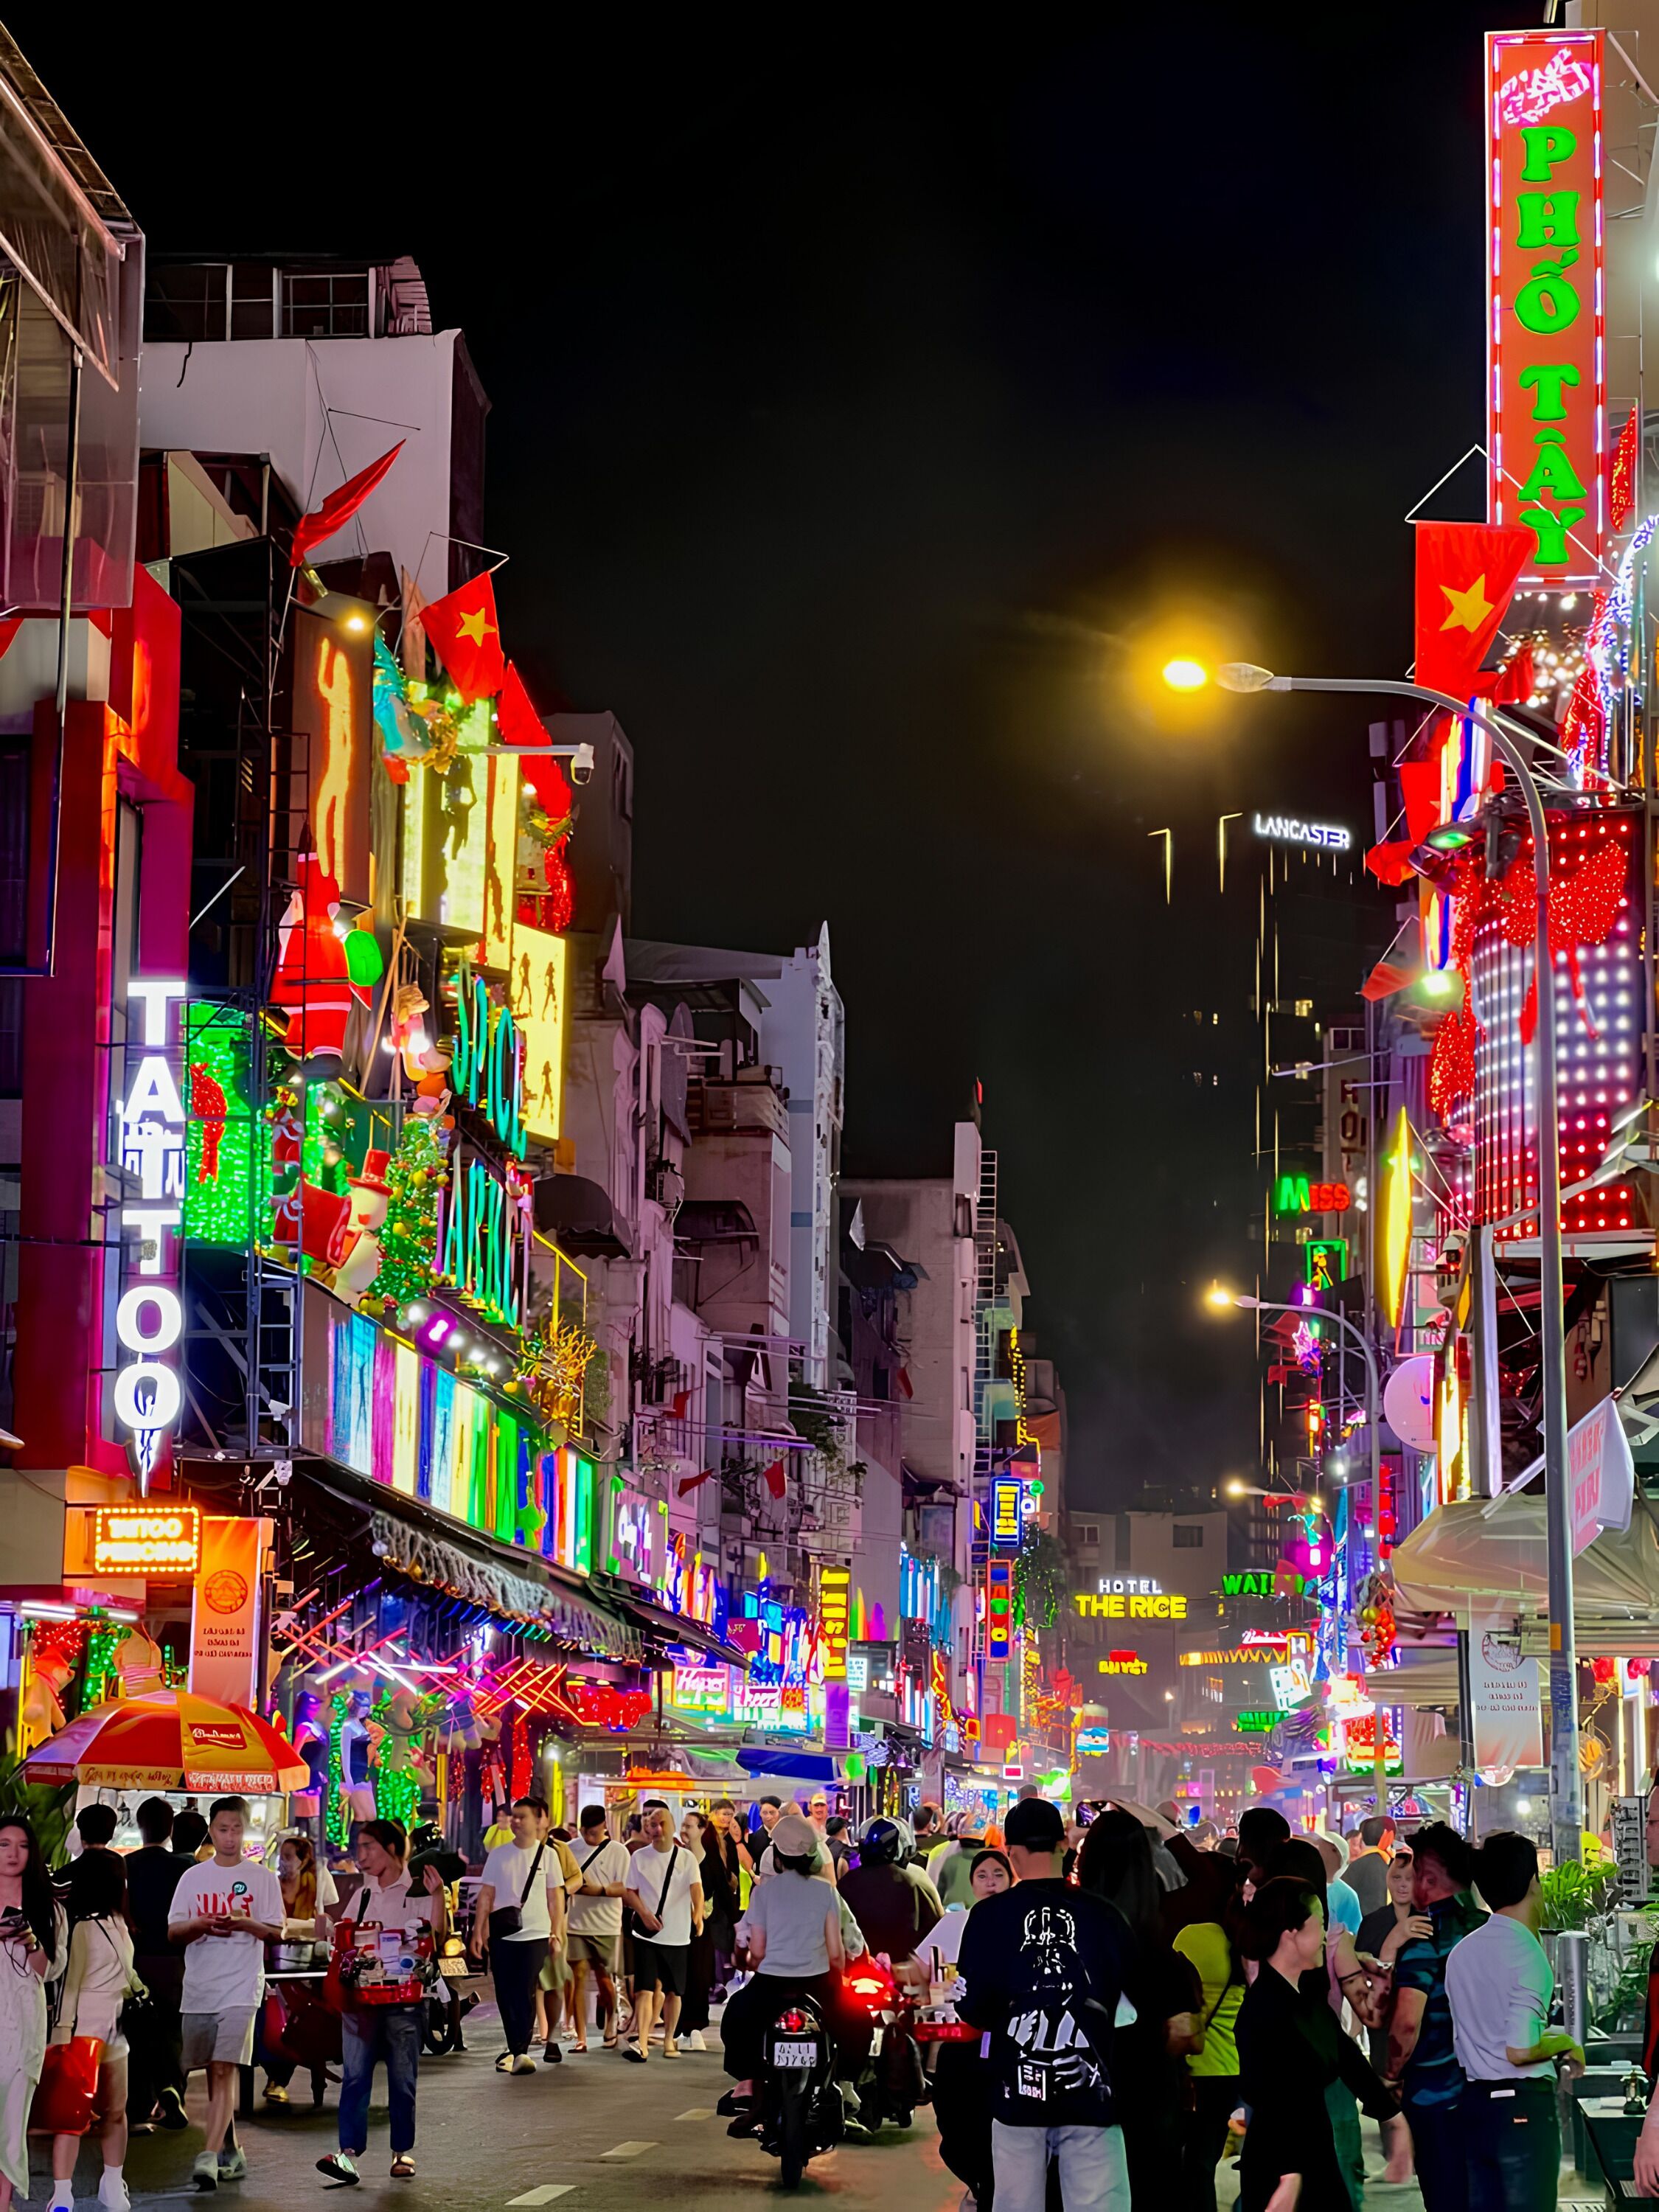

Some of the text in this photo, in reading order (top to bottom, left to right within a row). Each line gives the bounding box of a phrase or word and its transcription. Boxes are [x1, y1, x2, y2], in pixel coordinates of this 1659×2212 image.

[1514, 127, 1581, 334] PHỐ
[1518, 364, 1587, 565] TÂY
[1253, 813, 1351, 849] LANCASTER
[114, 981, 186, 1430] TATTOO
[1075, 1595, 1187, 1618] THE RICE
[1099, 1579, 1163, 1594] HOTEL
